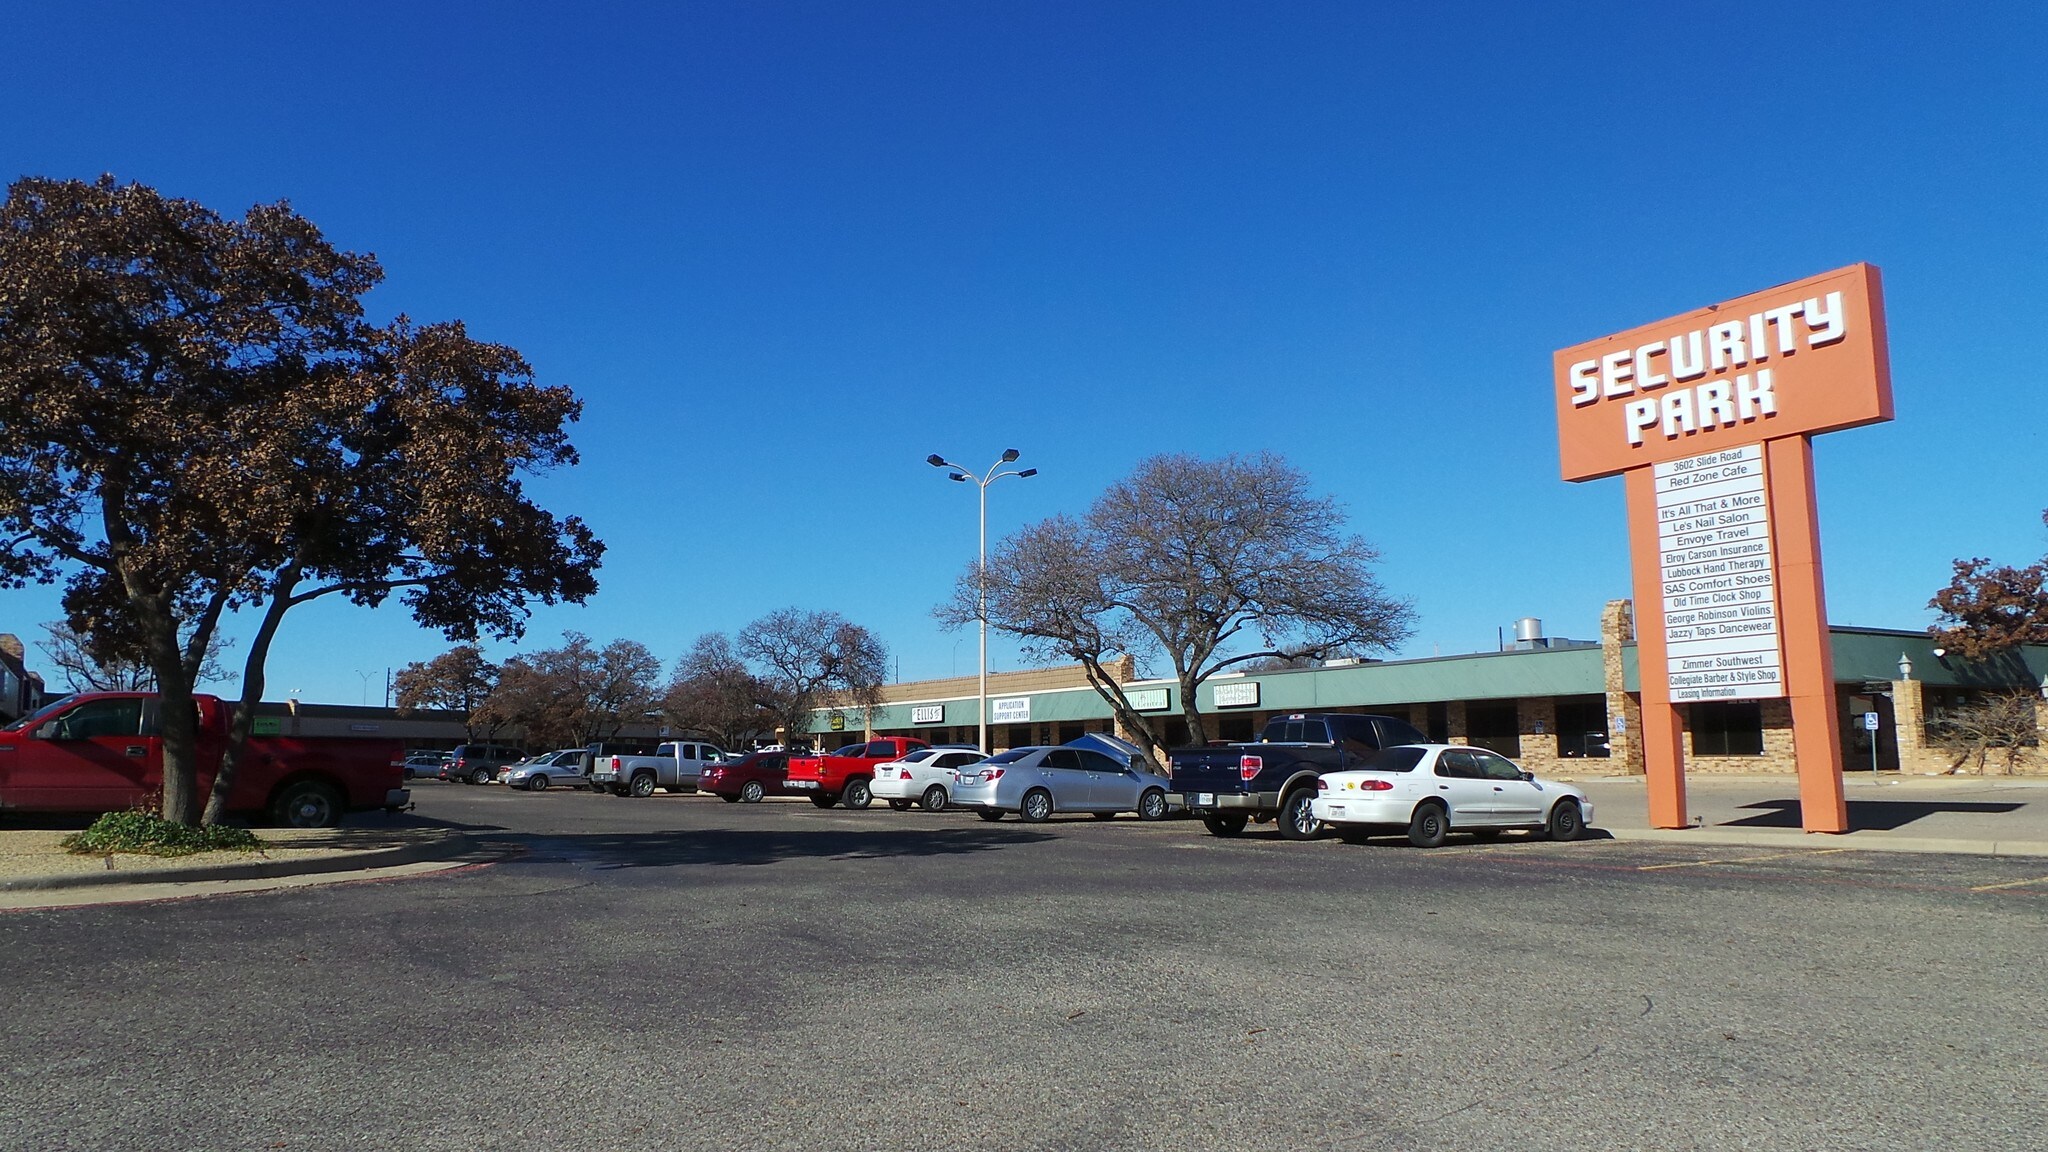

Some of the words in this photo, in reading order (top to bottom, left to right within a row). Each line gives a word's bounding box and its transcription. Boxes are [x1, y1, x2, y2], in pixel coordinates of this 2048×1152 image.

[1569, 291, 1845, 405] SECURITY
[1625, 368, 1776, 444] PARK
[1674, 459, 1694, 472] 3602
[1697, 455, 1717, 467] Slide
[1720, 449, 1742, 462] Road
[1670, 476, 1689, 487] Red
[1693, 471, 1718, 483] Zone
[1722, 466, 1747, 477] Cafe
[1662, 509, 1675, 519] It's
[1678, 506, 1691, 516] All
[1694, 502, 1716, 513] That
[1720, 500, 1728, 509] &
[1732, 495, 1760, 507] More
[1673, 522, 1692, 532] Le's
[1695, 517, 1715, 528] Nail
[1718, 513, 1749, 525] Salon
[1677, 533, 1713, 546] Envoye
[1716, 527, 1749, 540] Travel
[1666, 553, 1685, 564] Elroy
[1688, 548, 1717, 560] Carson
[1720, 543, 1763, 556] Insurance
[1667, 566, 1700, 578] Lubbock
[1703, 562, 1725, 574] Hand
[1729, 558, 1764, 571] Therapy
[1665, 583, 1686, 595] SAS
[1689, 578, 1732, 591] Comfort
[1735, 574, 1770, 586] Shoes
[1673, 597, 1687, 607] Old
[1689, 595, 1709, 606] Time
[1712, 592, 1736, 603] Clock
[1739, 589, 1761, 600] Shop
[1667, 613, 1695, 624] George
[1698, 609, 1737, 621] Robinson
[1740, 605, 1771, 616] Violins
[1669, 629, 1693, 639] Jazzy
[1695, 626, 1716, 638] Taps
[1719, 621, 1772, 633] Dancewear
[1682, 659, 1713, 669] Zimmer
[1716, 655, 1763, 667] Southwest
[1669, 675, 1702, 686] Collegiate
[1704, 672, 1728, 683] Barber
[1730, 672, 1736, 681] &
[1737, 670, 1756, 682] Style
[1757, 670, 1776, 680] Shop
[1678, 688, 1700, 699] Leasing
[1701, 687, 1736, 697] Information
[917, 708, 934, 720] ELLIS
[998, 700, 1025, 710] APPLICATION
[993, 711, 1012, 720] SUPPORT
[1013, 710, 1029, 719] CENTER
